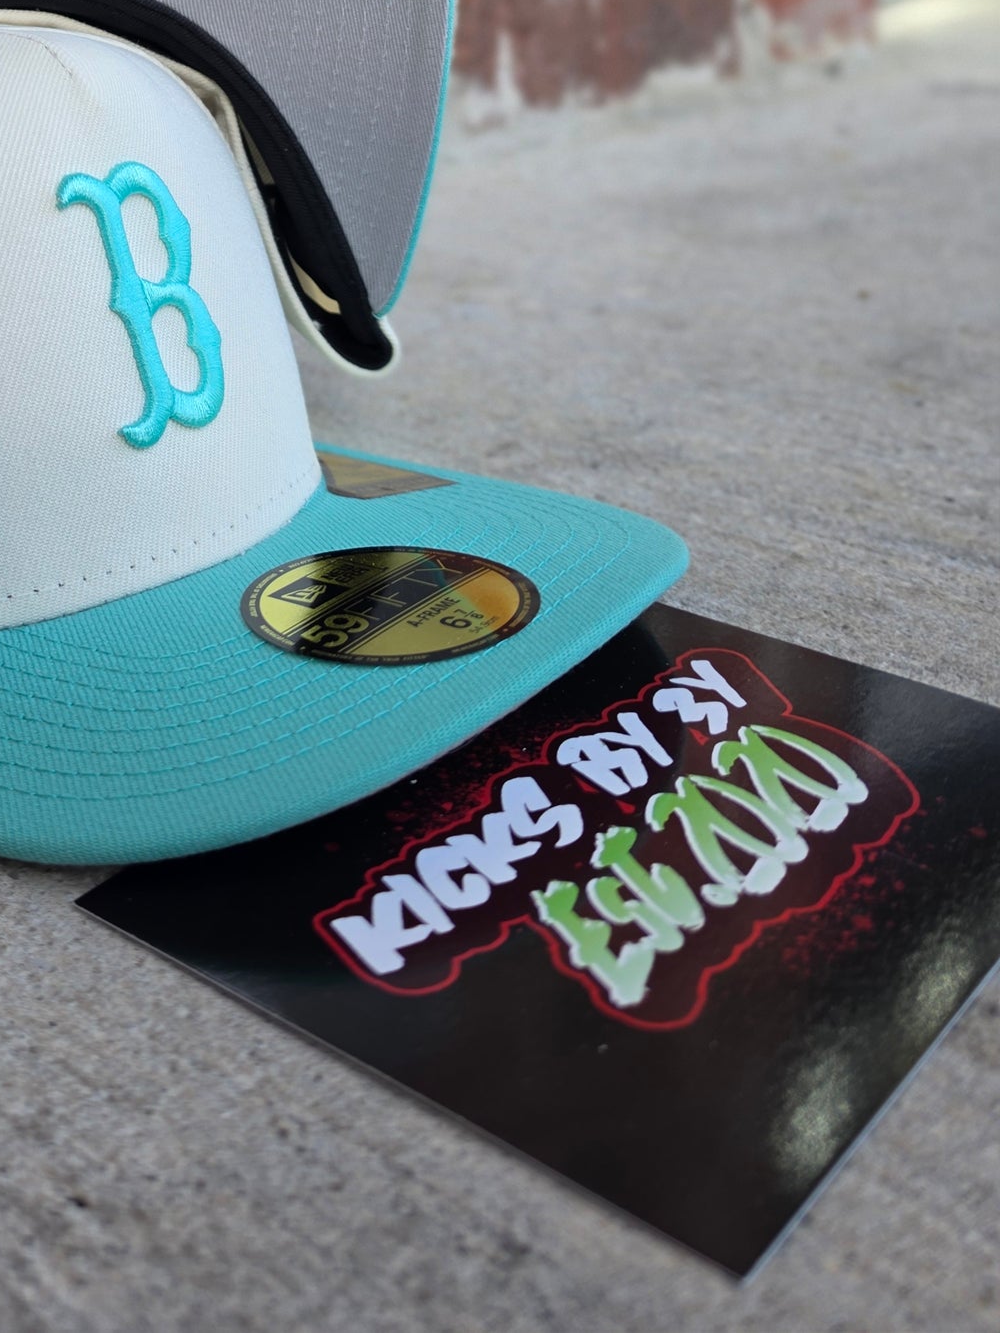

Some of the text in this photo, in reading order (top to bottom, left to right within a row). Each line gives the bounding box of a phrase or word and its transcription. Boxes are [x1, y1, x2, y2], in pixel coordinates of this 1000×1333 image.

[56, 161, 225, 449] B
[406, 597, 461, 628] A-FRAME
[331, 659, 748, 976] KICKS BY SY
[645, 724, 869, 907] 2020
